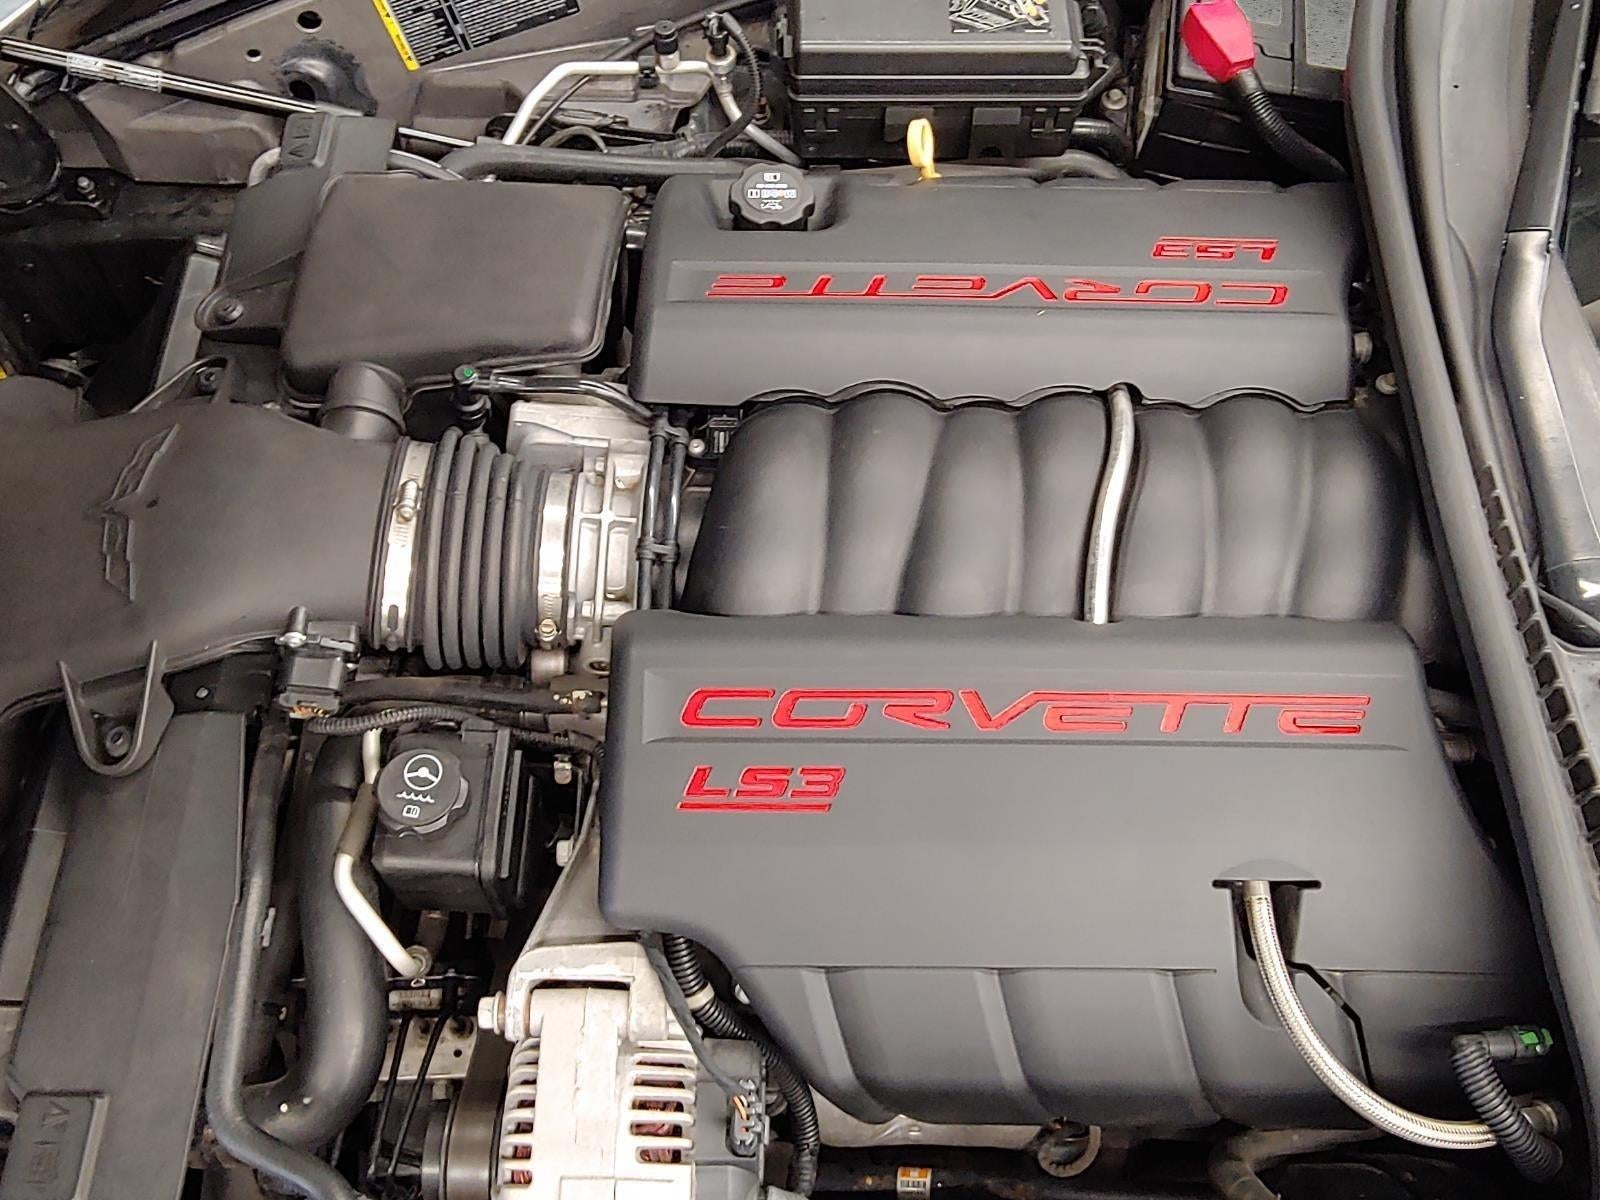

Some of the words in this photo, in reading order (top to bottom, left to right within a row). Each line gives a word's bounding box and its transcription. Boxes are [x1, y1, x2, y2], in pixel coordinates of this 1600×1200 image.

[1152, 240, 1277, 263] LS3
[706, 273, 1289, 308] CORVETTE
[680, 687, 1371, 735] CORVETTE
[683, 765, 846, 799] LS3
